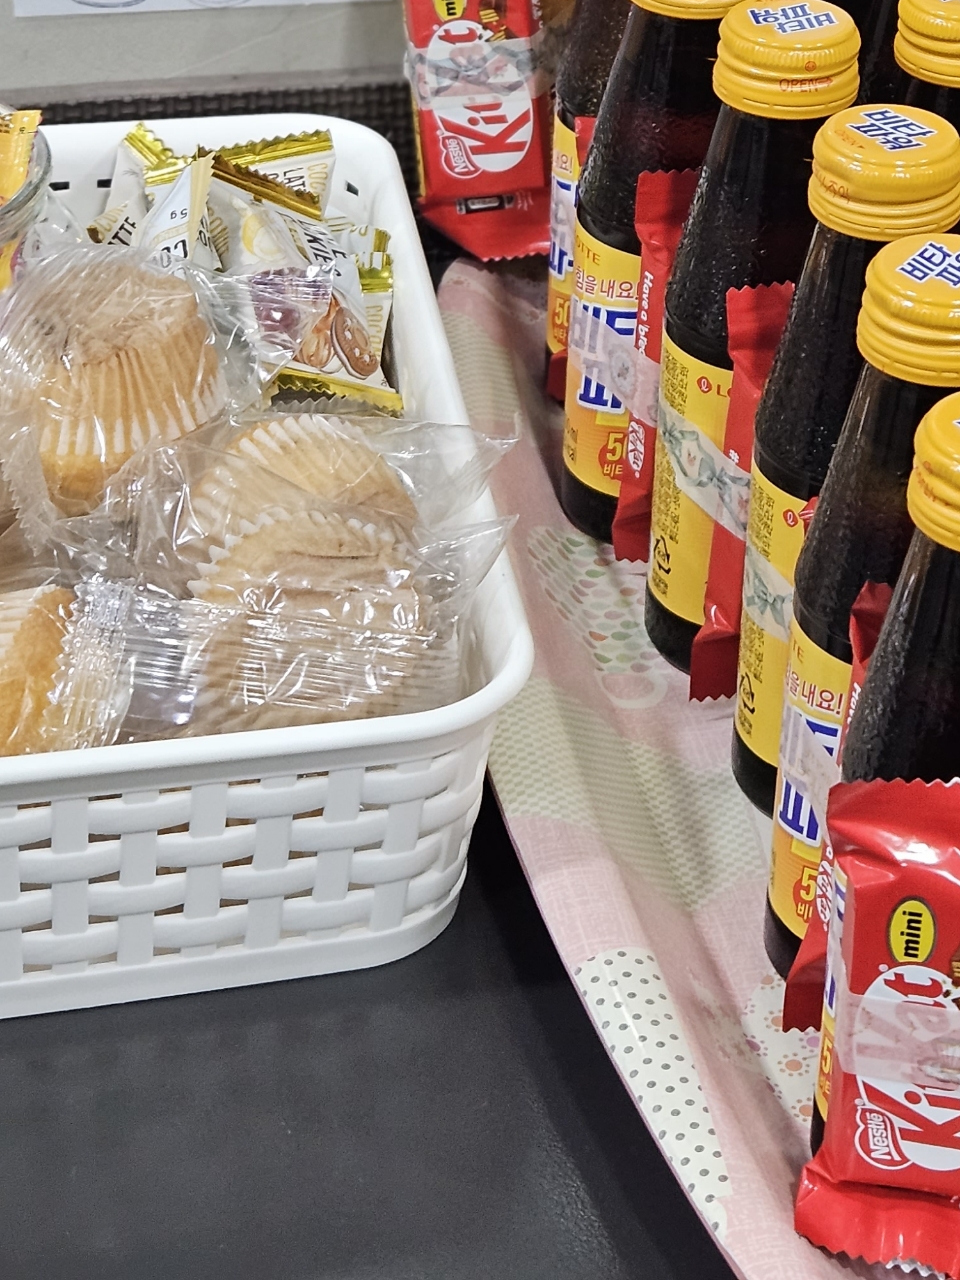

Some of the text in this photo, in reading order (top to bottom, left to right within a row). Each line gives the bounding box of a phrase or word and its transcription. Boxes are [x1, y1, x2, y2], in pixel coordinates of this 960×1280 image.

[749, 3, 810, 23] 파워
[777, 12, 836, 33] 비타
[862, 109, 937, 136] 비타
[846, 123, 926, 150] 파워
[897, 242, 951, 281] 비타
[900, 909, 923, 959] mini
